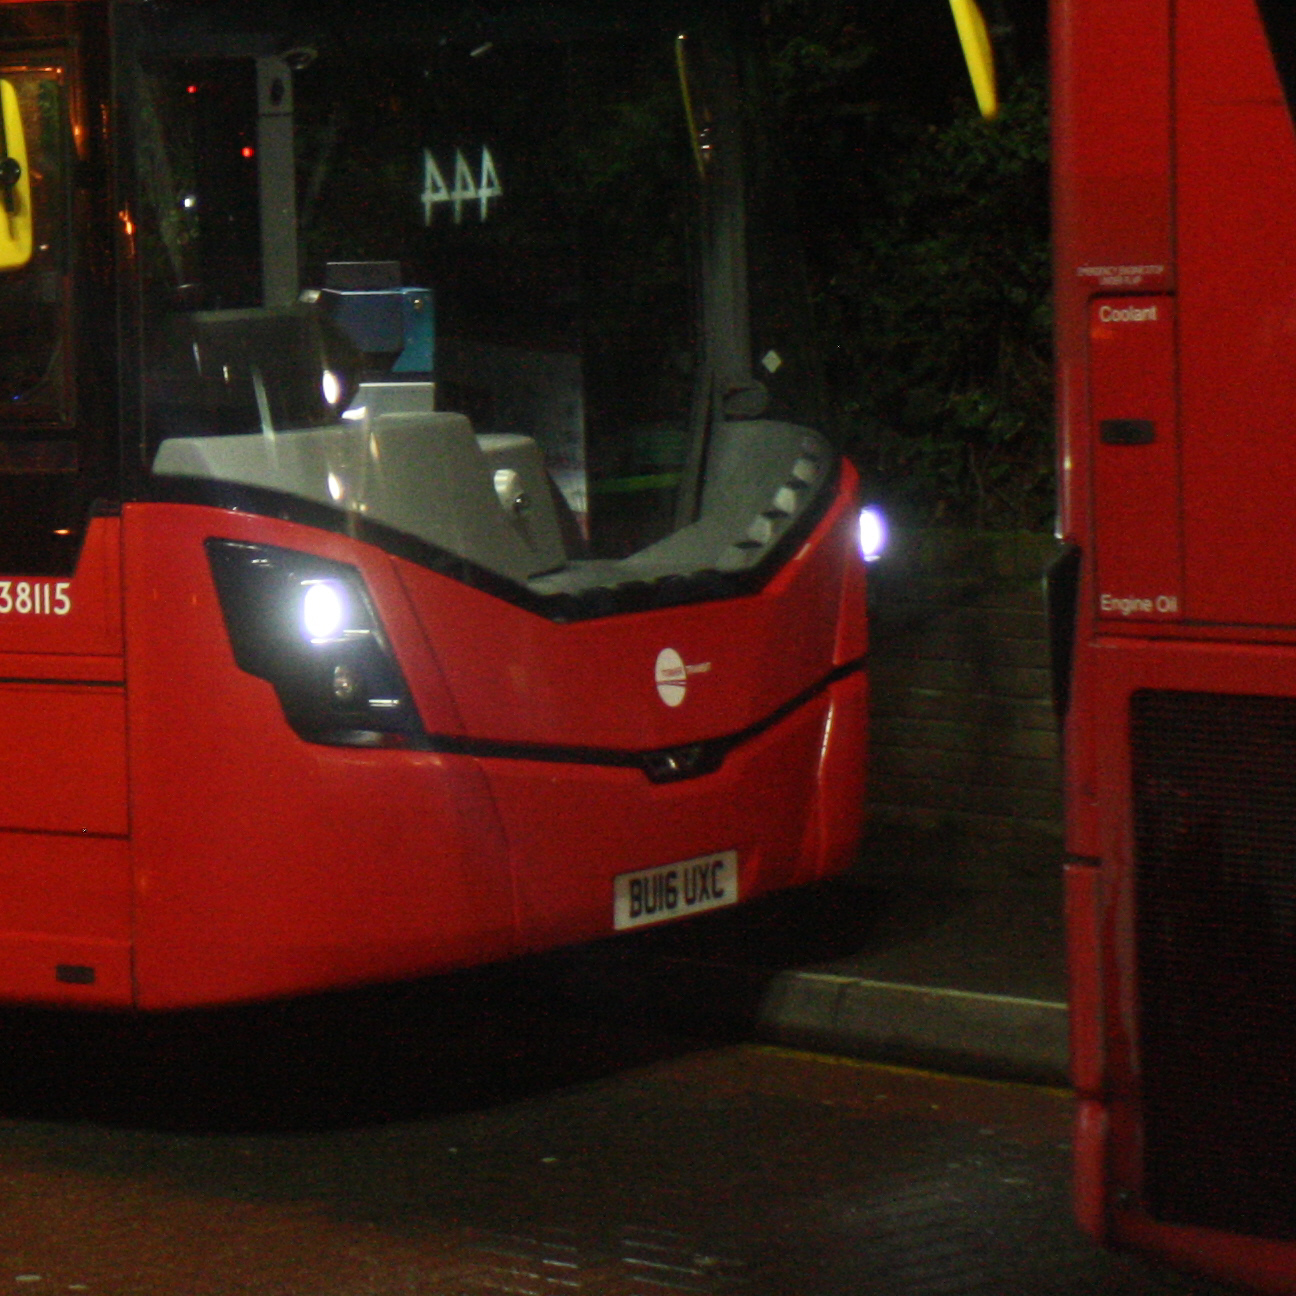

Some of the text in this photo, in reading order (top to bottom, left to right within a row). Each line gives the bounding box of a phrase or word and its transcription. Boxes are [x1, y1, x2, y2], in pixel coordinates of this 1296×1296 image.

[1099, 305, 1157, 323] Coolant
[1101, 593, 1178, 616] Engine Oil
[629, 859, 725, 919] BU16 UXC
